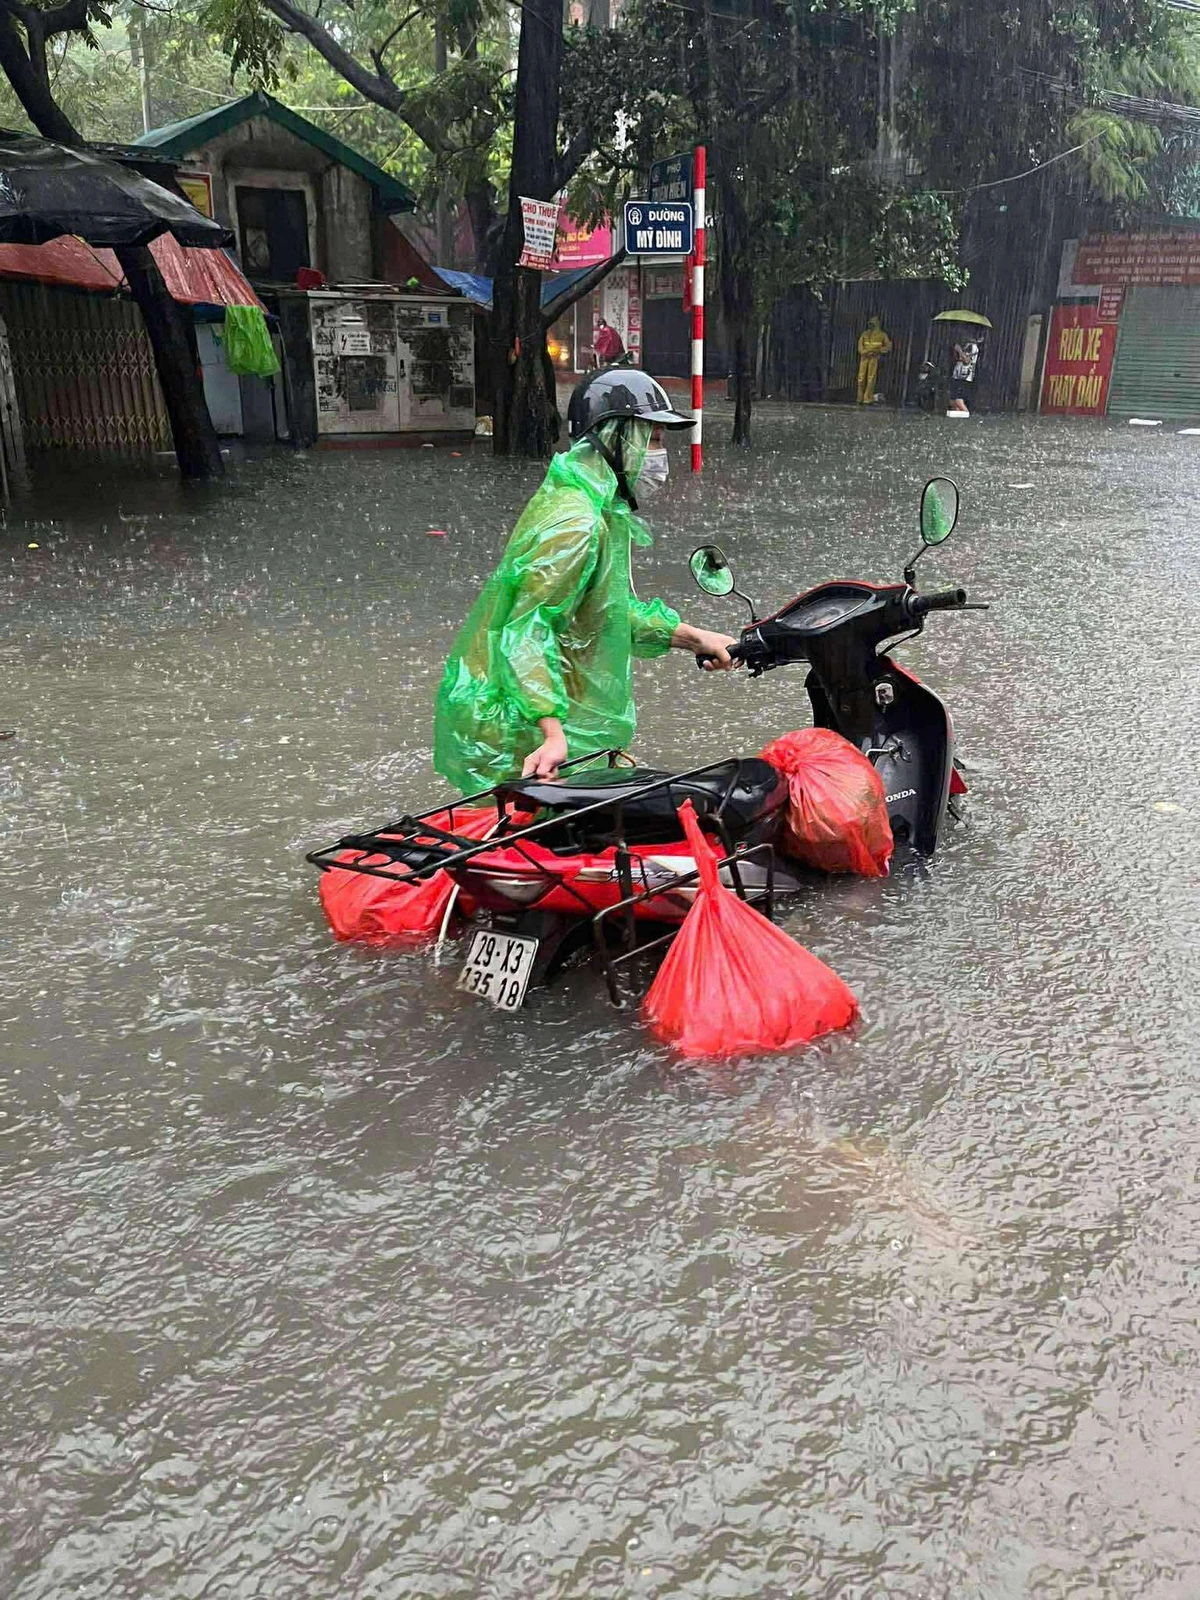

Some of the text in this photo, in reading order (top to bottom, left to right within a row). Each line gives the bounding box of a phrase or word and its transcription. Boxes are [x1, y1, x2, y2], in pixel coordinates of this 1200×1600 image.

[521, 202, 536, 214] CHO
[648, 207, 685, 222] ĐƯỜNG
[636, 226, 682, 249] MỸ ĐÌNH
[1084, 327, 1103, 361] XE
[1048, 374, 1077, 407] THAY
[885, 788, 917, 803] ONDA
